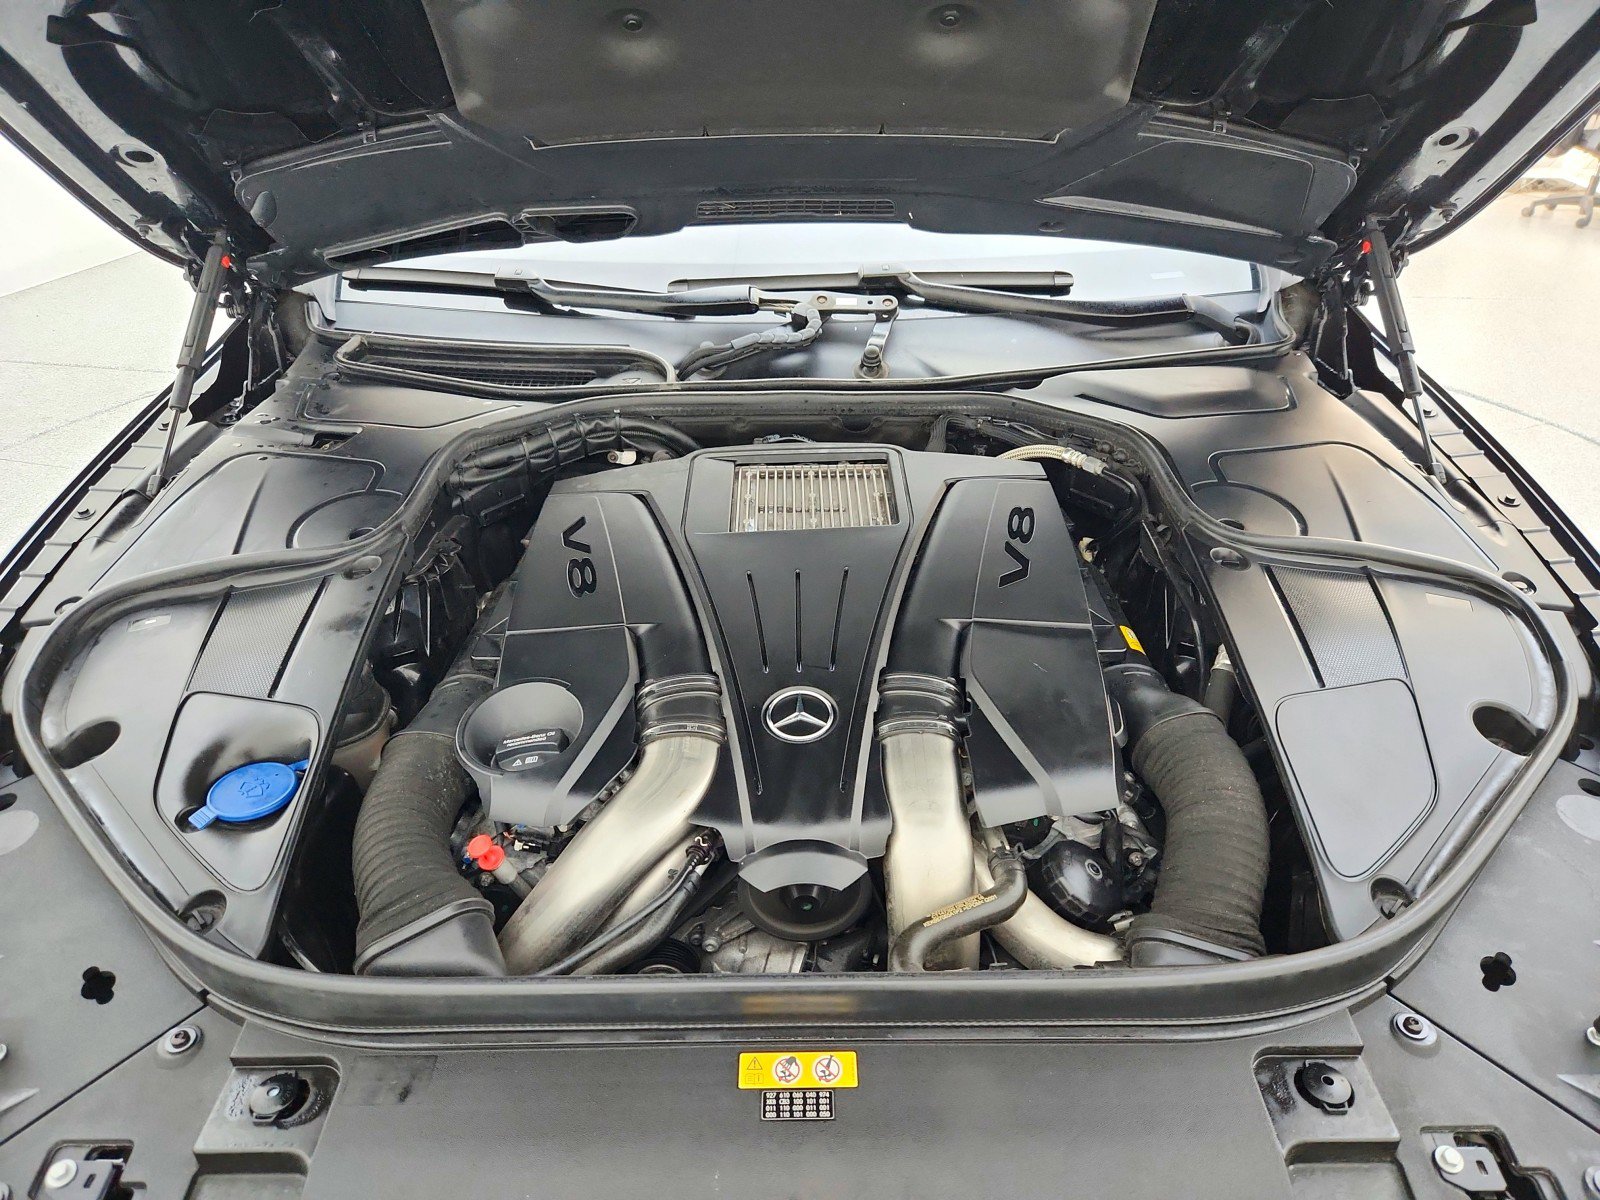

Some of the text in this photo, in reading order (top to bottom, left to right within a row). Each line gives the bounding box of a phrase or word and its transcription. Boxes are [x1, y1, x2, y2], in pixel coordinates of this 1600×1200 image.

[561, 516, 597, 599] V8
[998, 506, 1036, 589] V8
[503, 733, 546, 744] Mercedes-Benz
[506, 736, 547, 747] recommended
